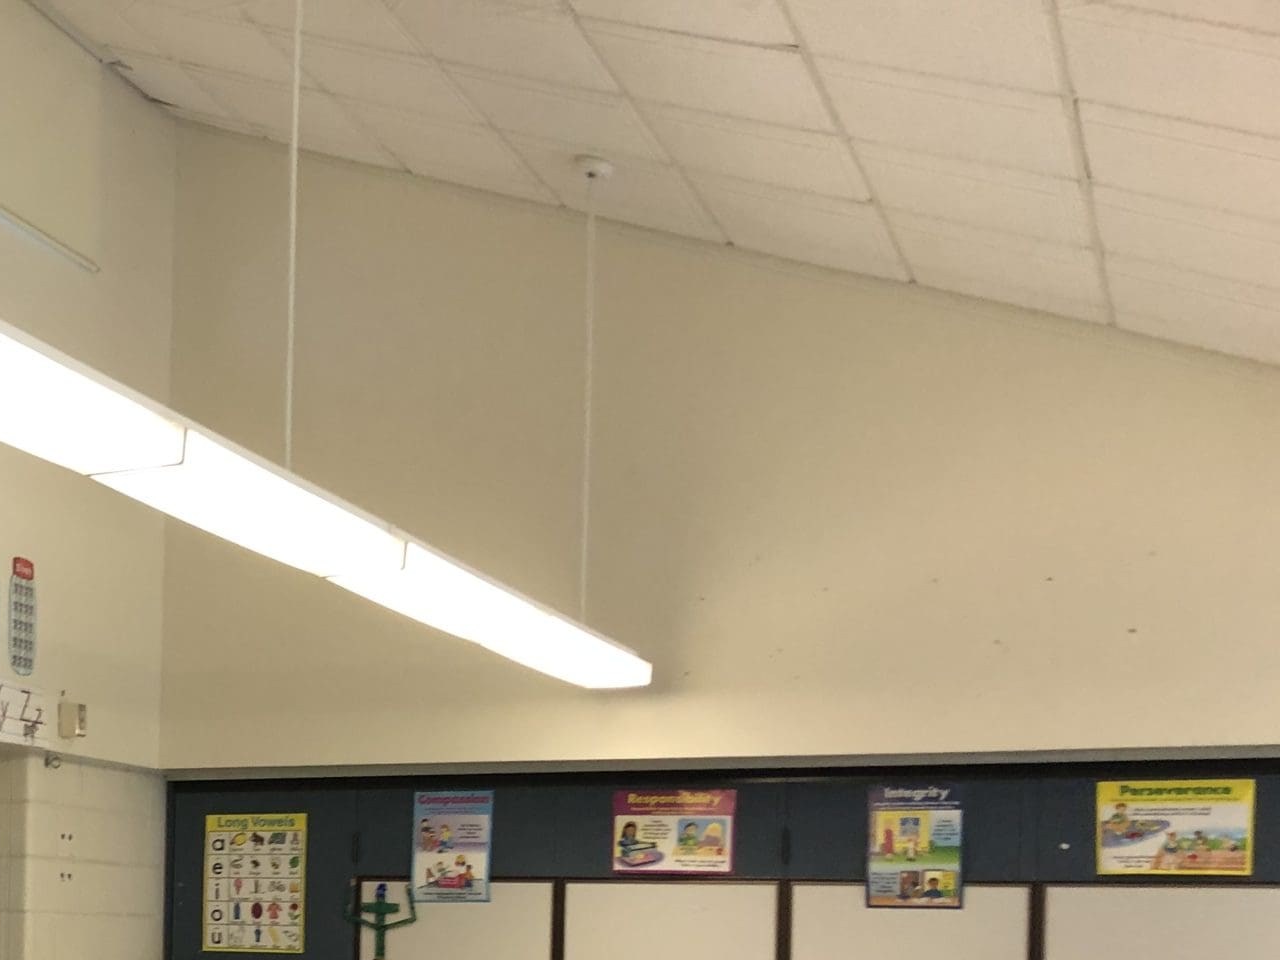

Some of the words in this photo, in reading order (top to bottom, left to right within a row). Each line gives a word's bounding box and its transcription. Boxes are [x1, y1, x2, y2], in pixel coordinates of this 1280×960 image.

[883, 786, 950, 801] Integrity
[1120, 785, 1232, 797] Perseverance
[627, 791, 720, 806] Responsibility
[217, 817, 248, 829] Long
[251, 815, 296, 828] Vowels
